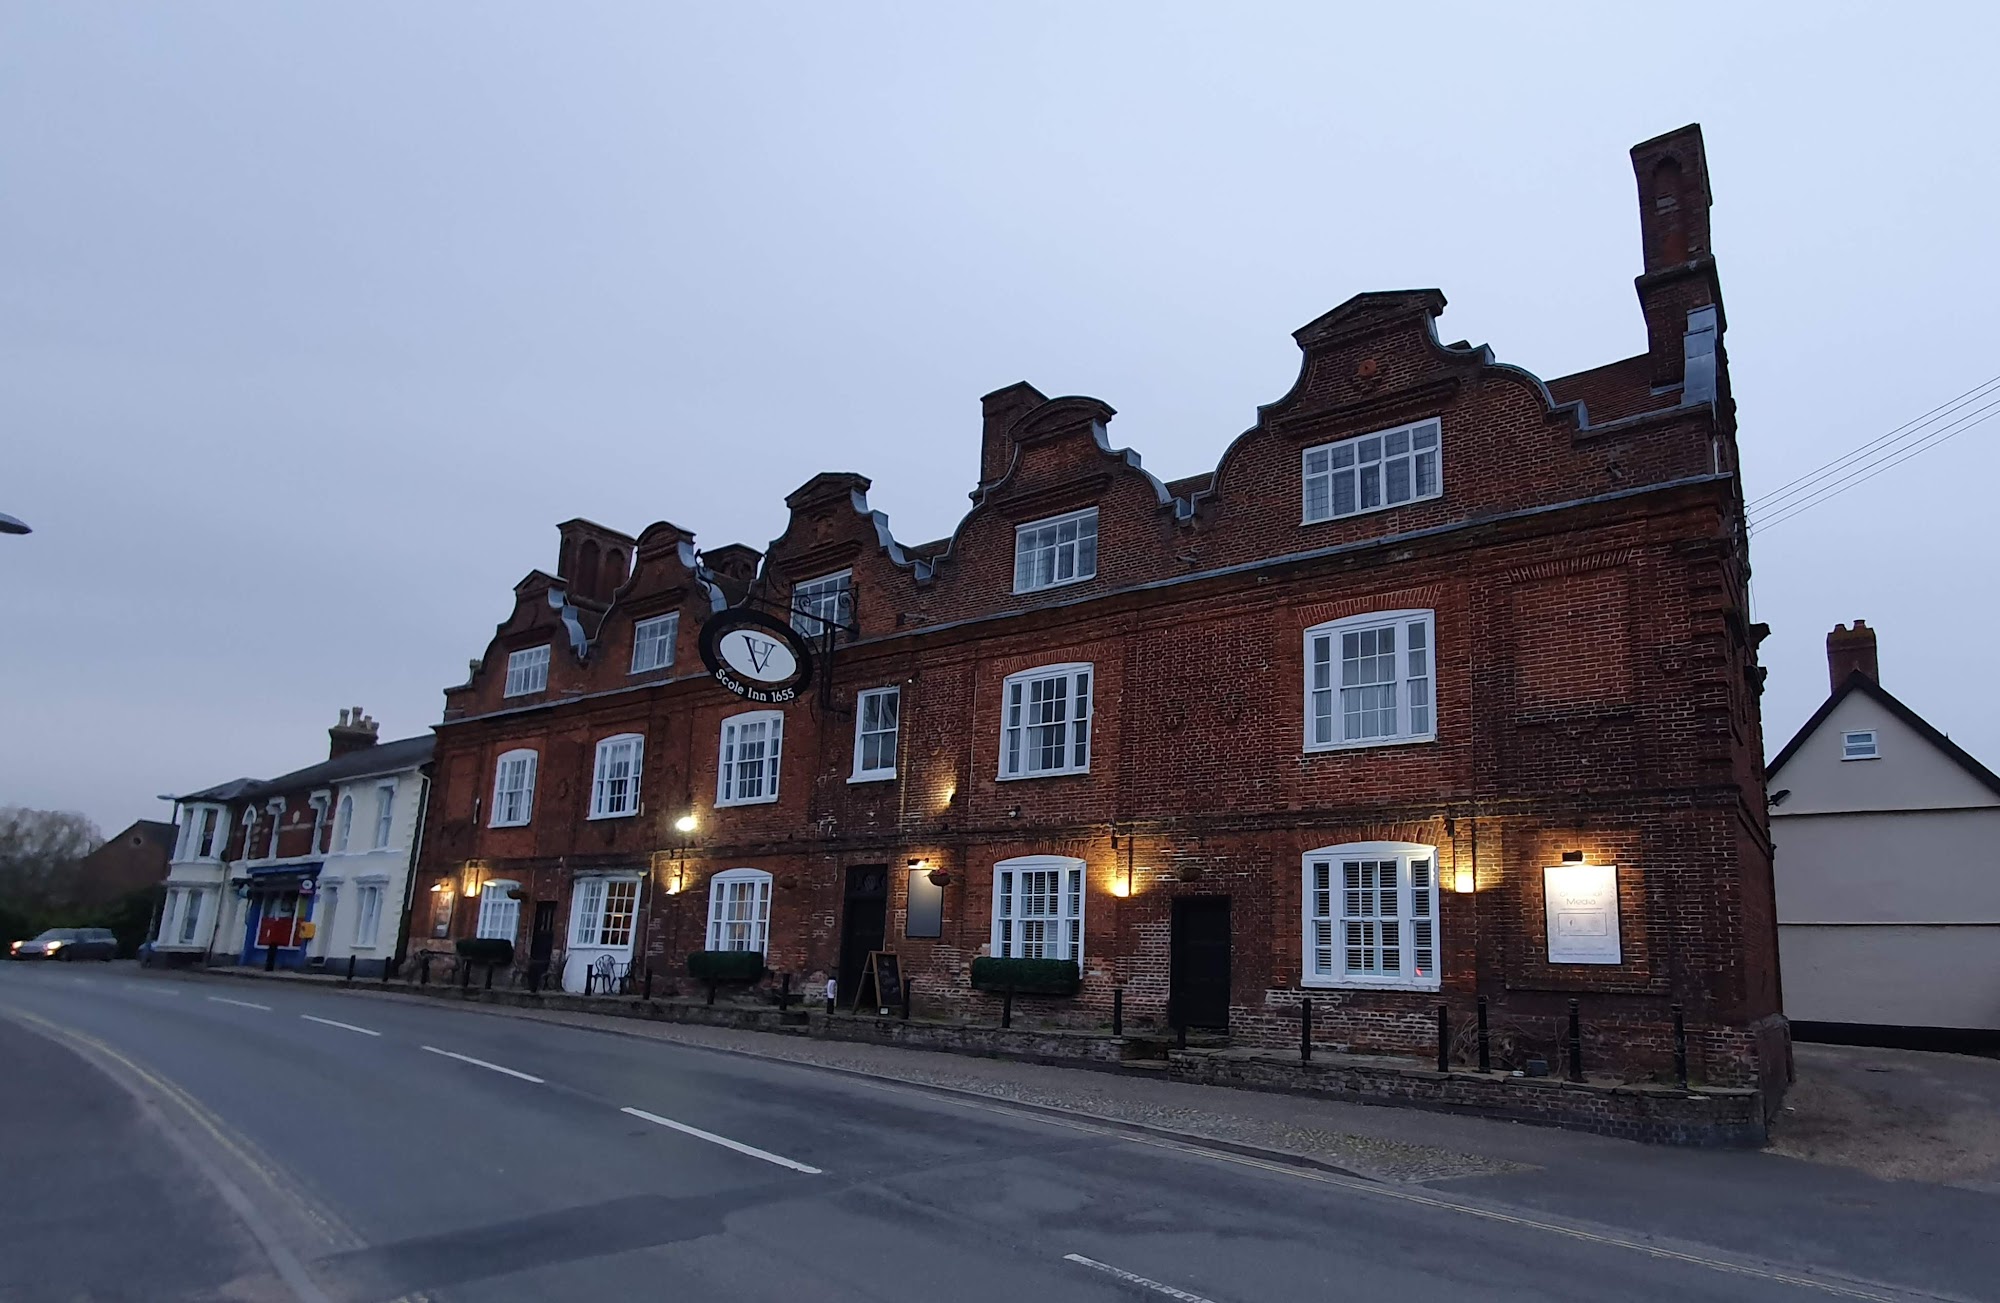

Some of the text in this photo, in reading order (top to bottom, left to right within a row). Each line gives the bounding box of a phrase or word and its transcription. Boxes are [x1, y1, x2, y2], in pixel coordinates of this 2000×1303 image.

[715, 668, 795, 703] Scole Inn 1655
